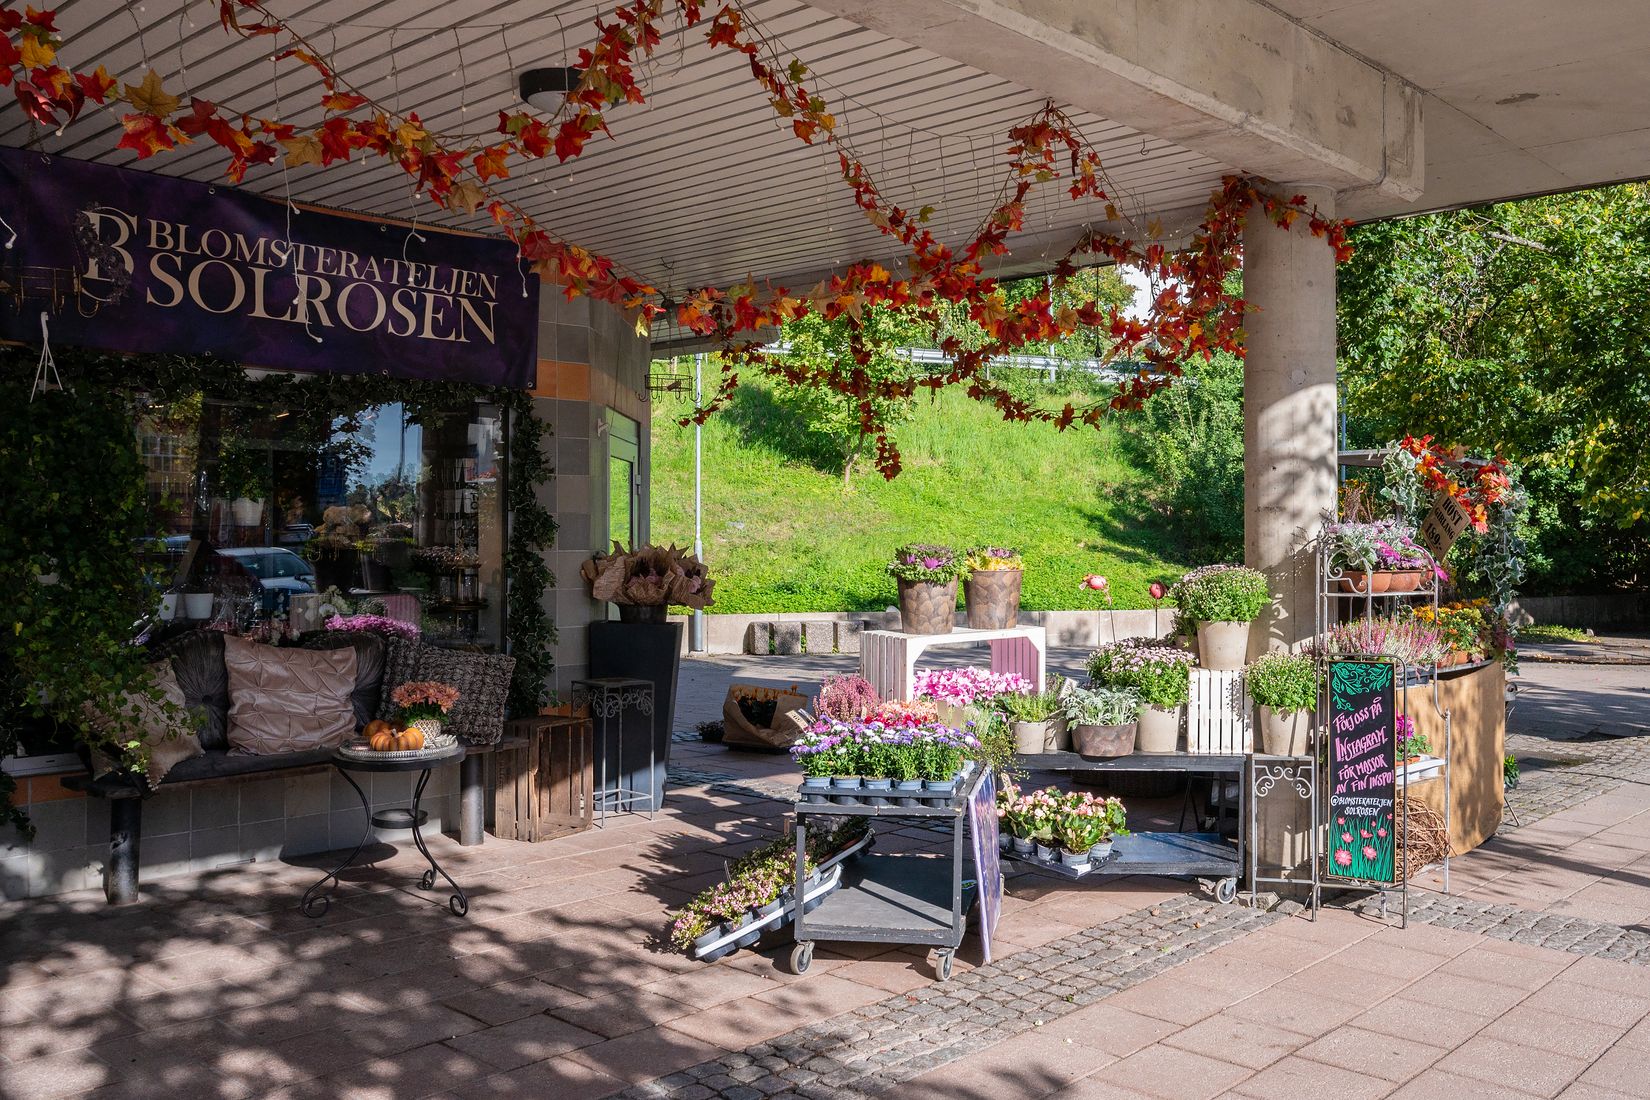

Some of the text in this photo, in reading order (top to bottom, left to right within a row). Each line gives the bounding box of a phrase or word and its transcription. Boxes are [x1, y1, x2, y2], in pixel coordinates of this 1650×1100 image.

[146, 218, 499, 300] BLOMSTERATELJEN
[146, 252, 499, 345] SOLROSEN
[1435, 507, 1456, 540] GIRLANG
[1442, 497, 1463, 526] HÖST
[1332, 696, 1383, 734] FÖLJ OSS PÅ
[1335, 726, 1388, 762] INSTAGRAM
[1335, 769, 1395, 795] AV FIN INSPO!
[1338, 753, 1388, 781] FÖR MASSOR
[1330, 795, 1394, 808] @BLOMSTERATELJEN
[1344, 806, 1381, 818] SOLROSEN
